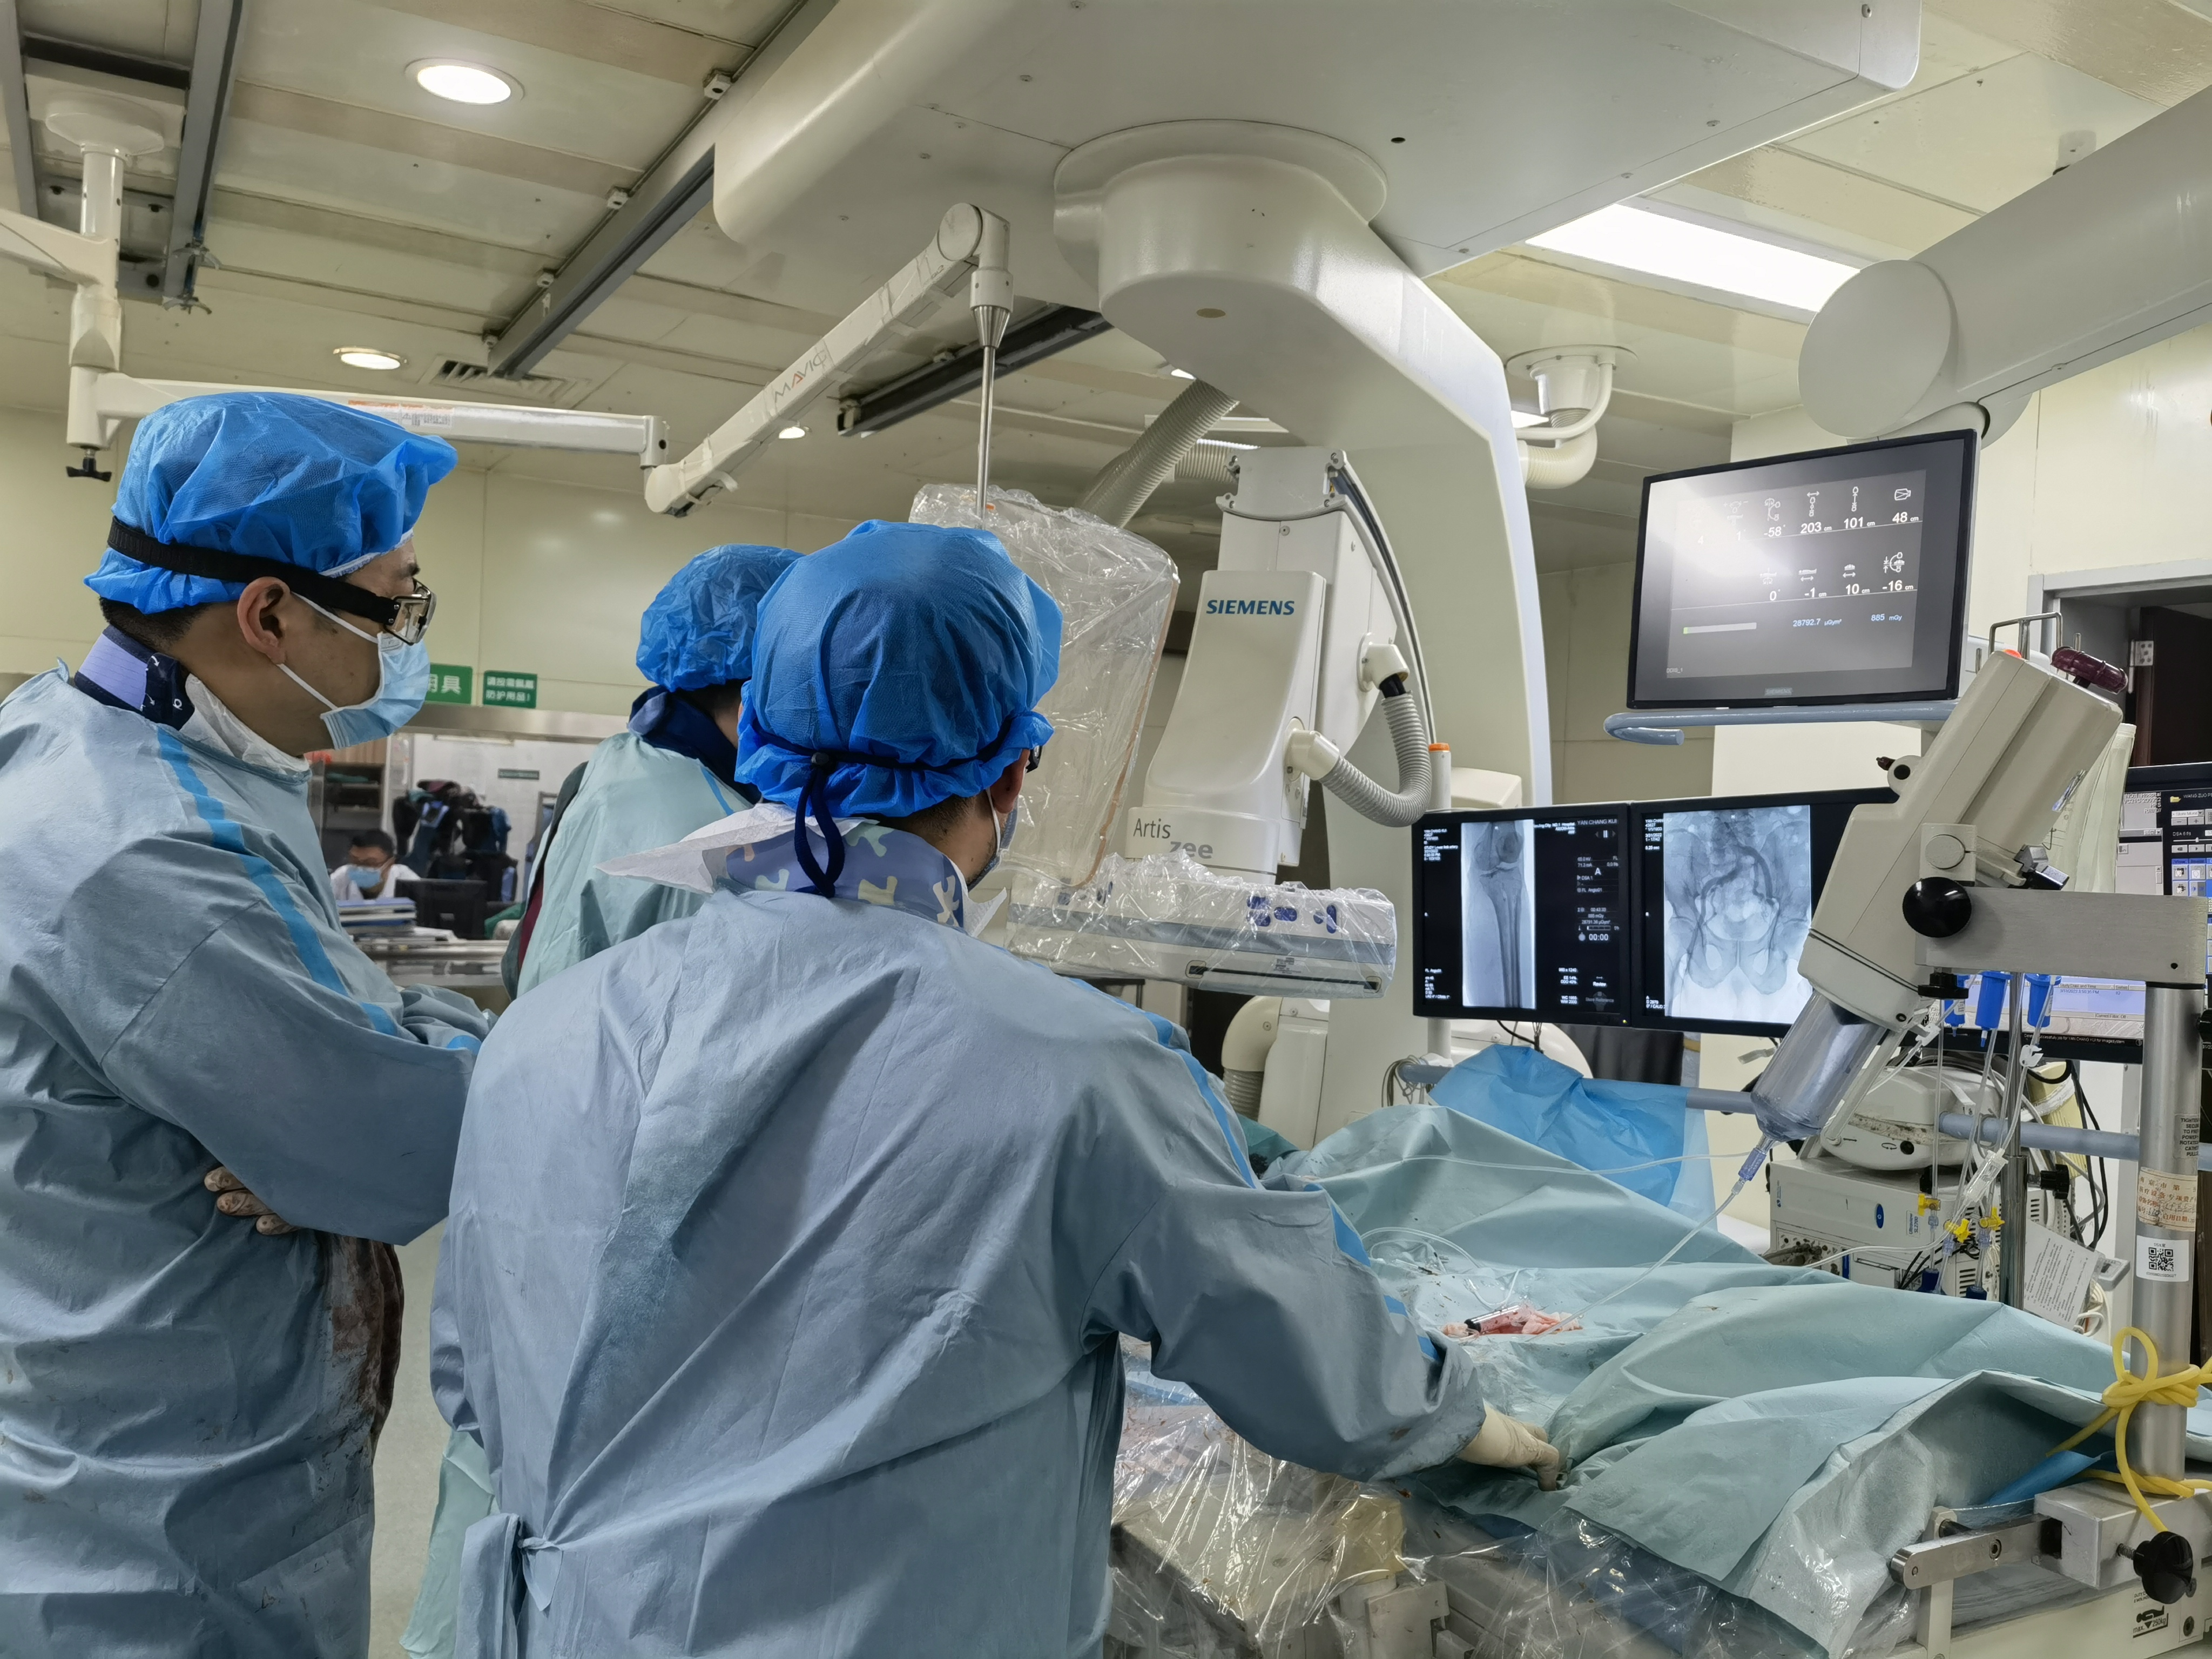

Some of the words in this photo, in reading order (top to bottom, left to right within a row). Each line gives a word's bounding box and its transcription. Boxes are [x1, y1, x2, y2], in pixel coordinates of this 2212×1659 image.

[1843, 517, 1864, 530] 101
[1892, 511, 1907, 523] 48
[1800, 521, 1822, 534] 203
[1845, 583, 1860, 595] 10
[1882, 579, 1903, 592] -16
[1804, 587, 1816, 598] -1
[1206, 599, 1295, 616] SIEMENS
[1792, 618, 1821, 627] 28792.7
[1133, 818, 1171, 839] Artis
[1170, 841, 1213, 859] zee
[1594, 867, 1602, 875] A
